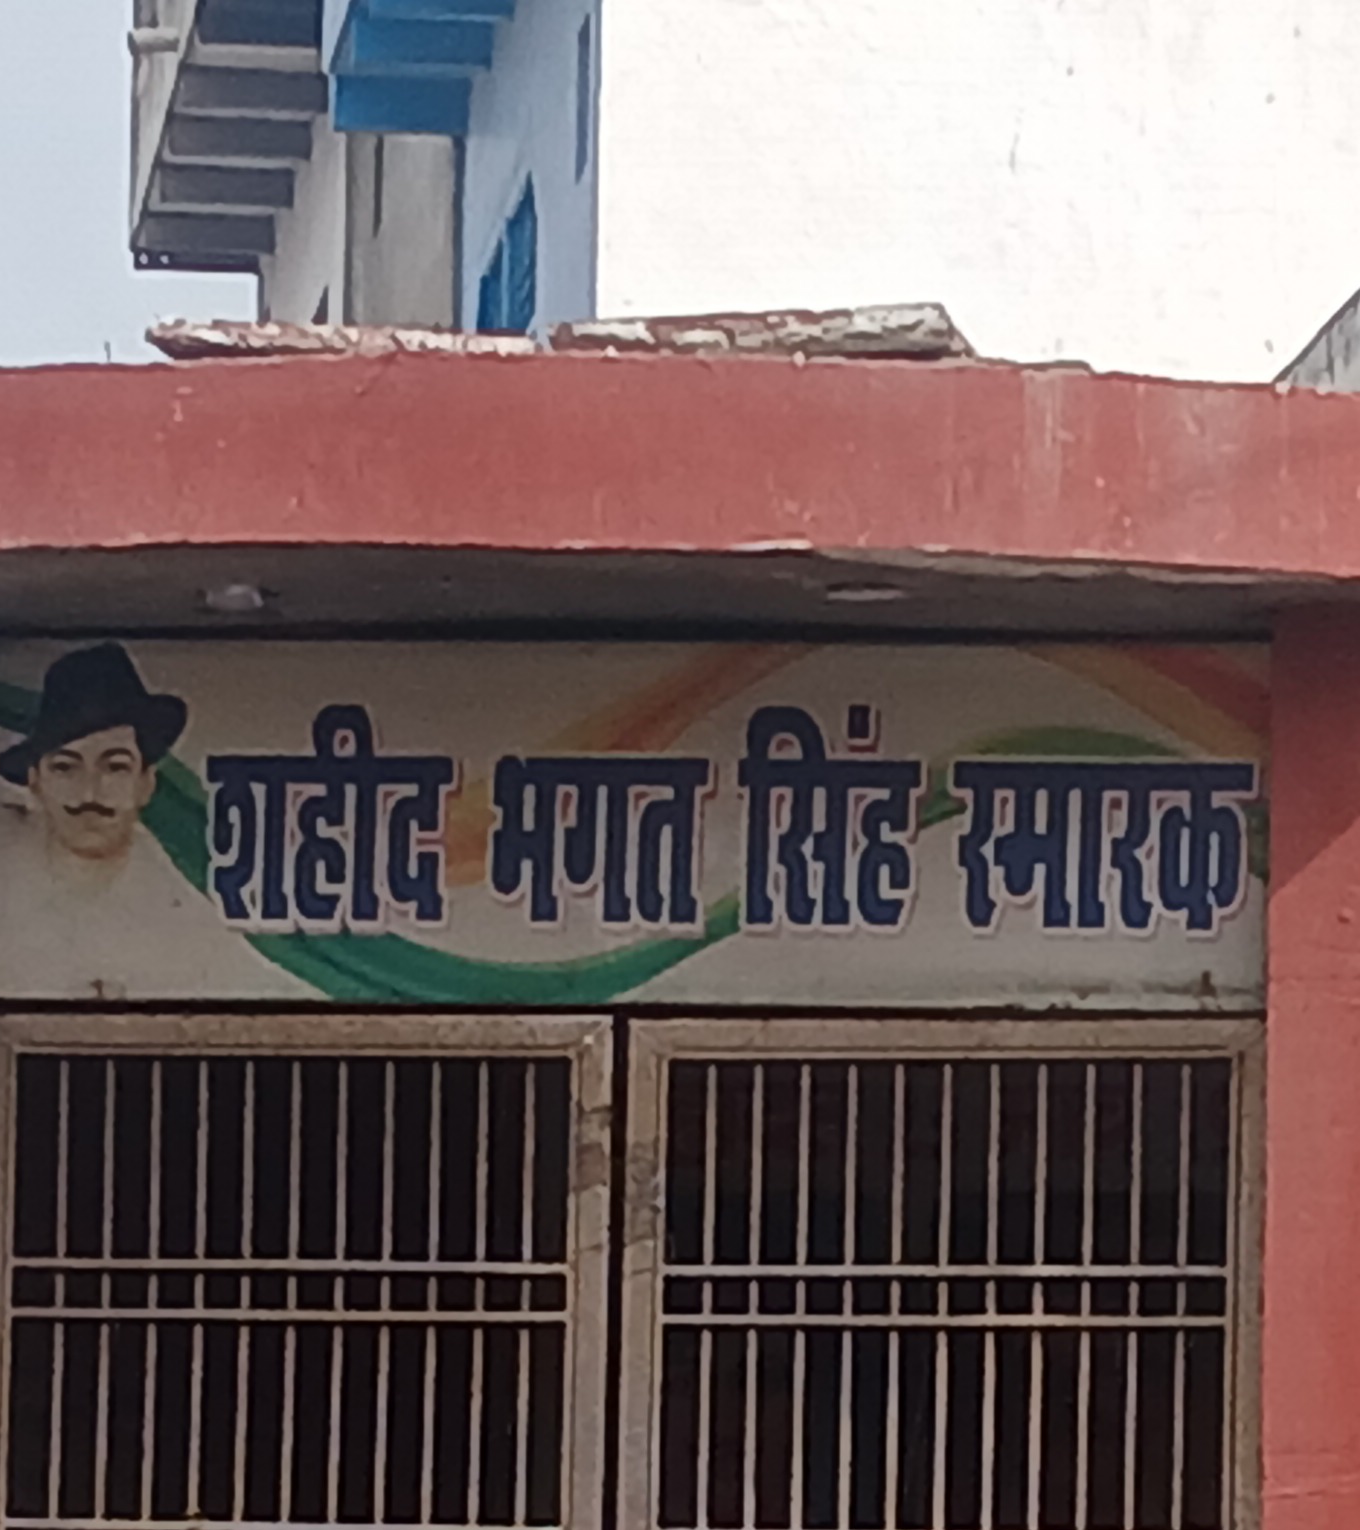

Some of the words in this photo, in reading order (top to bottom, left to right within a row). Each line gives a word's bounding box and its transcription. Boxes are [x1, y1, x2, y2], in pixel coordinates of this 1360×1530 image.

[206, 705, 453, 920] शहीद
[492, 756, 710, 923] भगत
[737, 705, 921, 925] सिंह
[953, 761, 1254, 930] स्मारक
